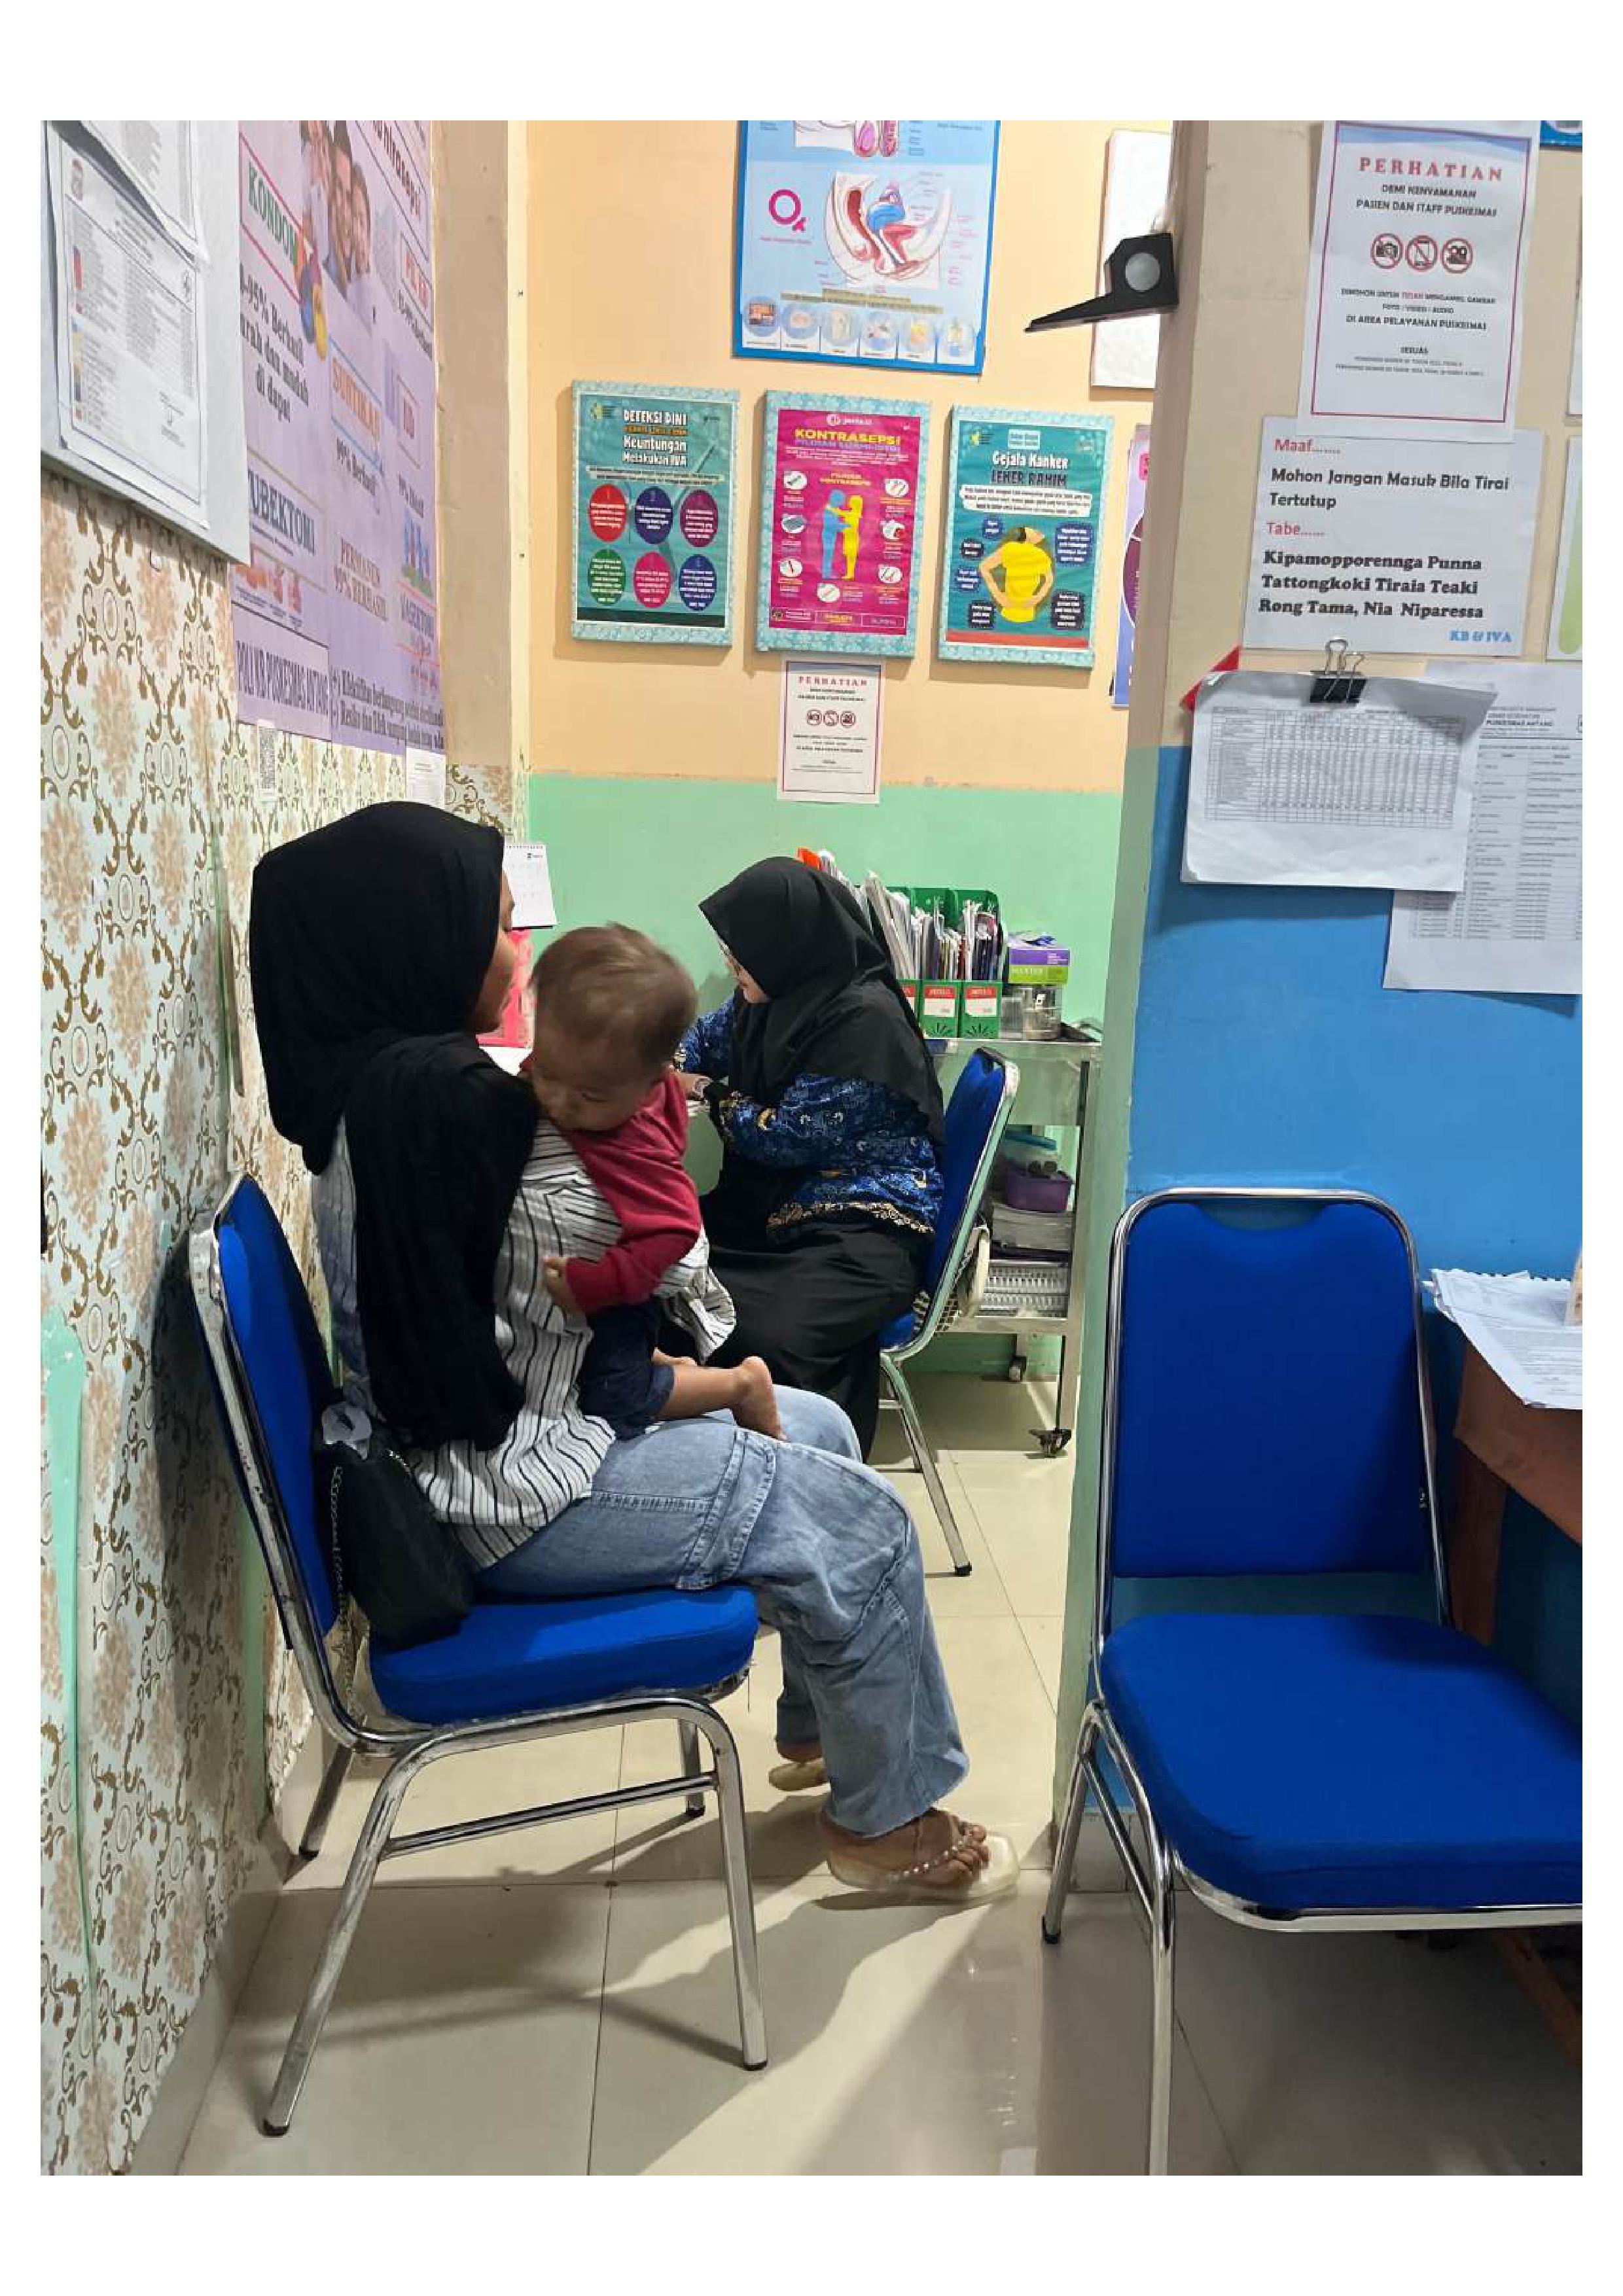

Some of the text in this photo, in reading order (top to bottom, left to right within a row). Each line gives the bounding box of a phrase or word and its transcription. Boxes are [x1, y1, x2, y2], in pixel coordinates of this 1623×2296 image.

[1358, 156, 1503, 181] PERHATIAN
[1382, 184, 1477, 198] DEMI KENYAMANAN
[1356, 199, 1497, 217] PASIEN DAN STAFF PUSKESMAS
[1383, 317, 1438, 327] PELAYANAN
[624, 409, 687, 425] DETEKSI DINI
[624, 434, 687, 455] Keuntungan
[794, 429, 901, 445] KONTRASEPSI
[992, 450, 1069, 470] Gejala Kanker
[991, 469, 1067, 487] LEHER RAHIM
[1271, 468, 1509, 491] Mohon Jangan Masuk Bila Tirai
[1270, 492, 1337, 510] Tertutup
[1262, 550, 1482, 571] Kipamopporennga Punna
[1261, 574, 1479, 595] Tattongkoki Tiraia Teaki
[1258, 599, 1484, 620] Rong Tama, Nia Niparessa
[1449, 629, 1512, 643] KB & IVA
[798, 676, 868, 686] PERHATIAN
